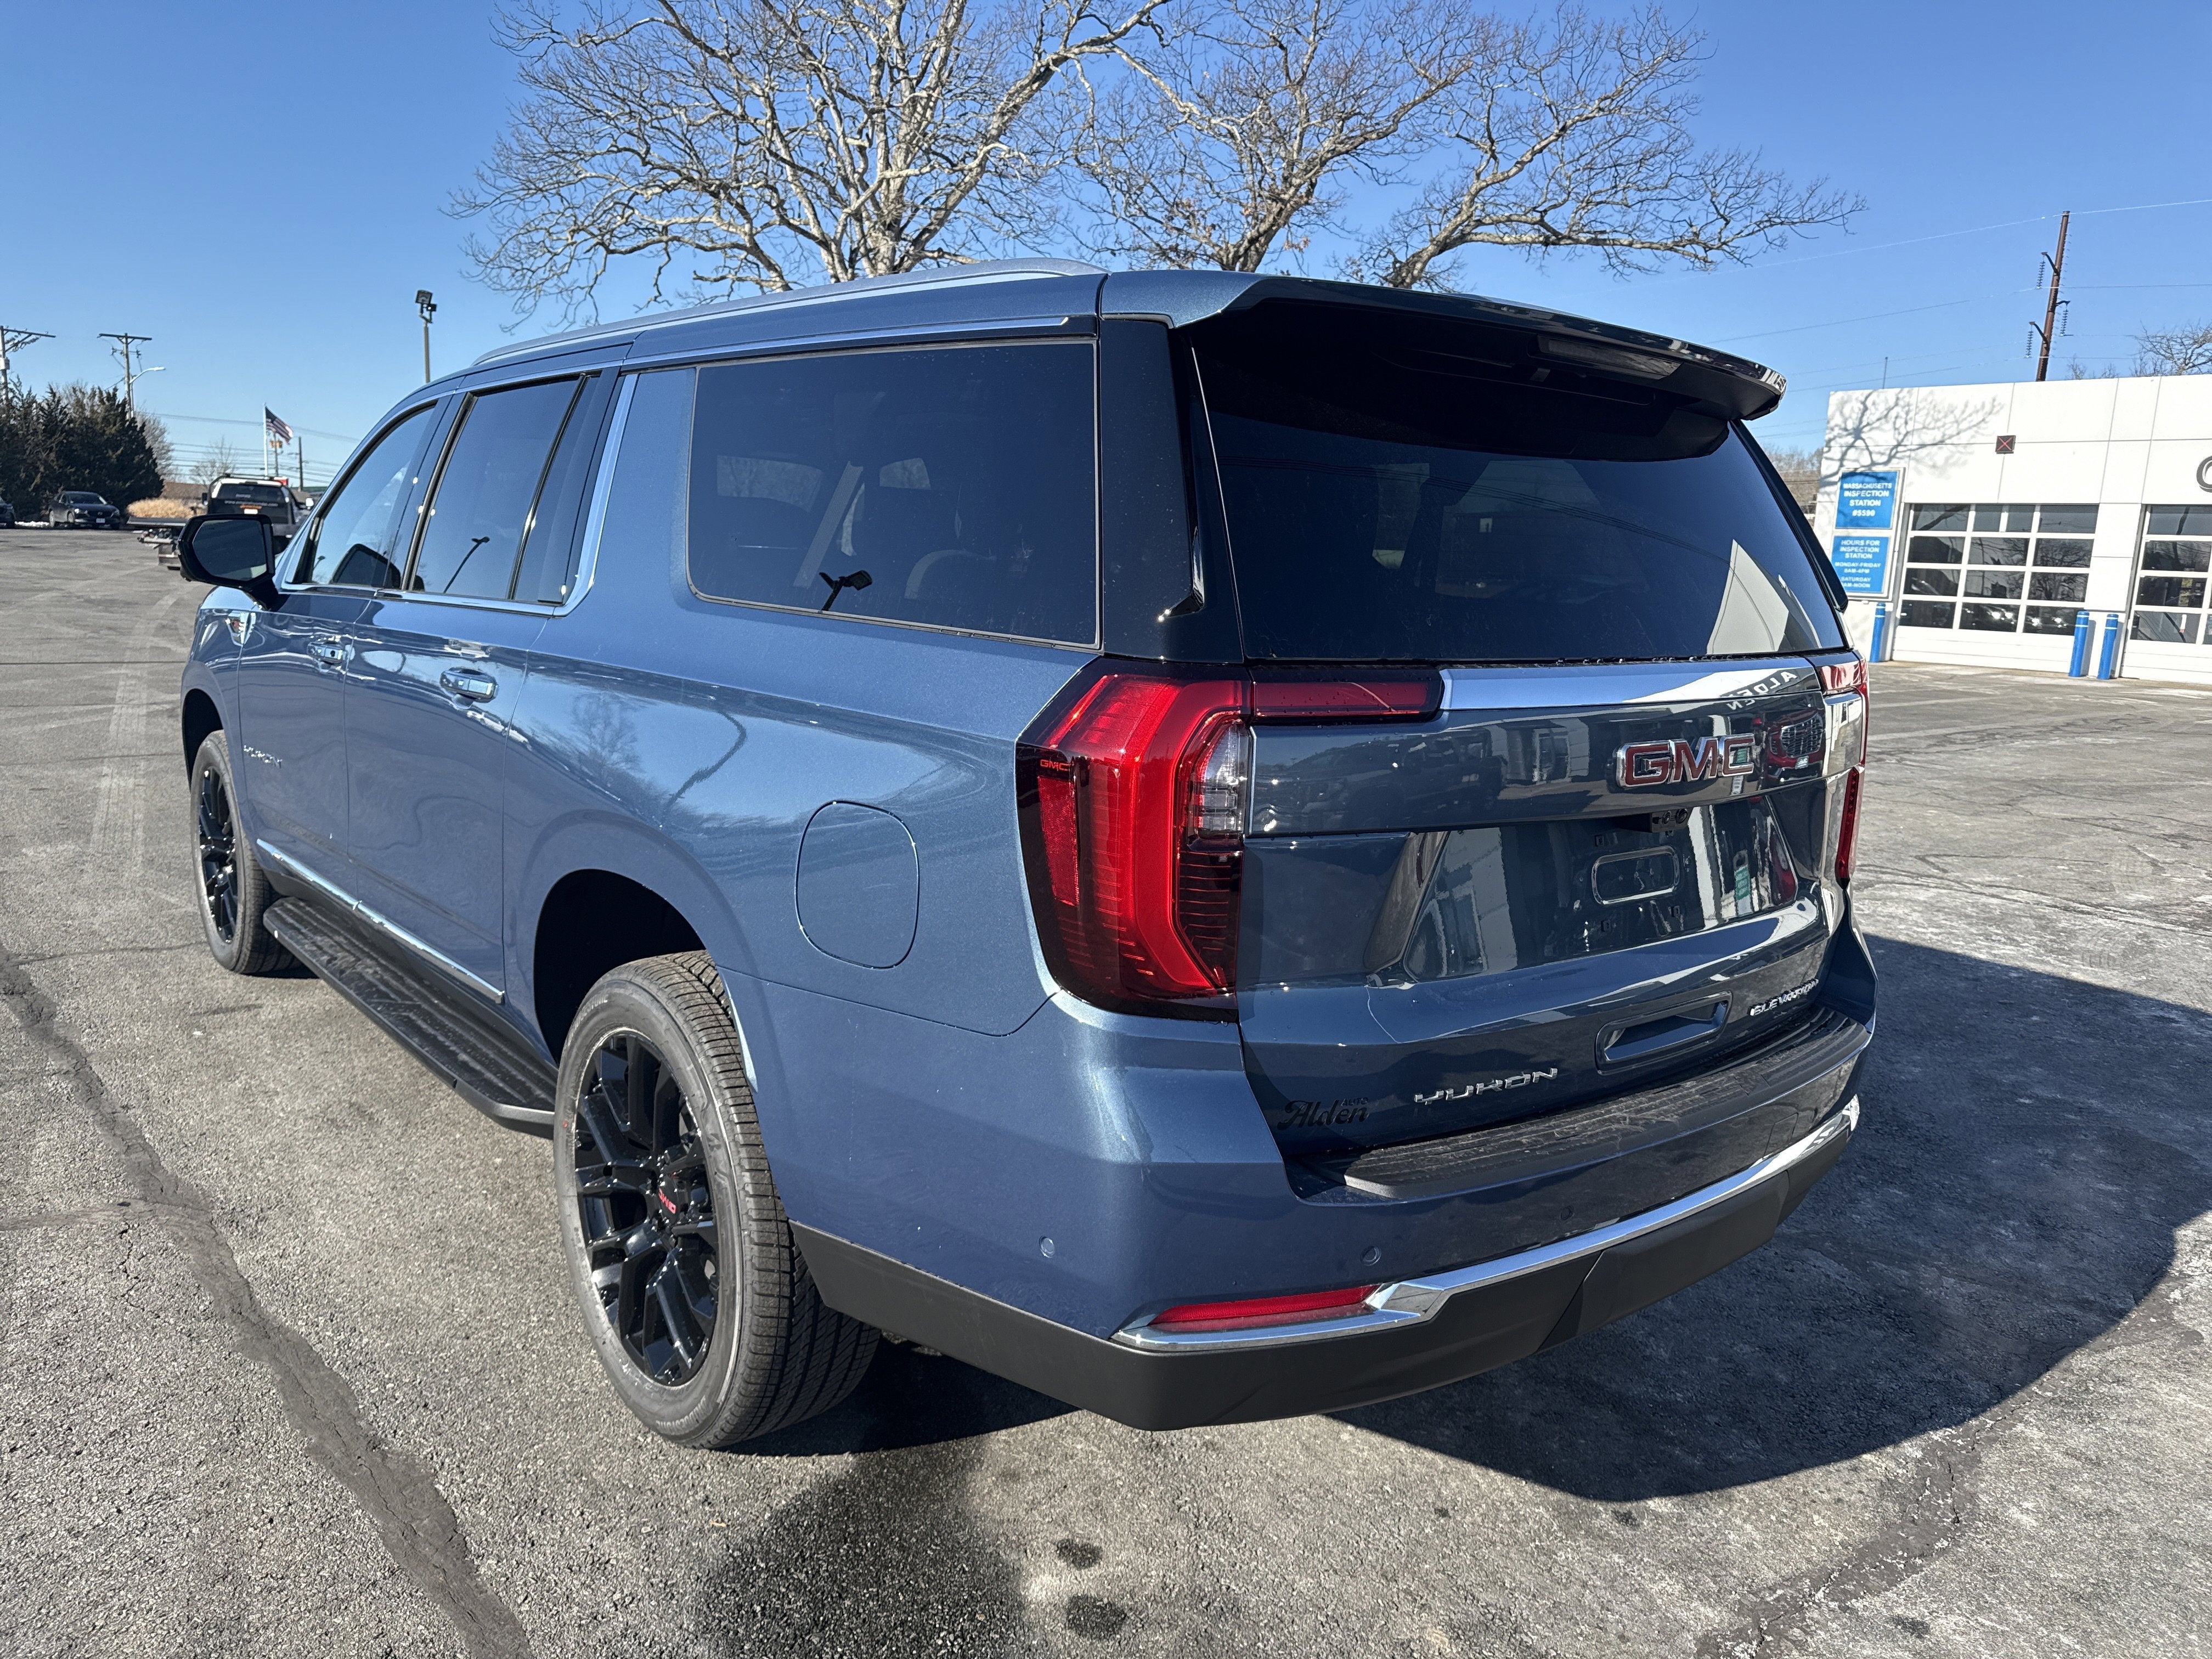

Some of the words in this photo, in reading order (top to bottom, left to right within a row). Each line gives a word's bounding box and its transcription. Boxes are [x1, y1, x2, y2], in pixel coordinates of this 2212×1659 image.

[1040, 759, 1070, 771] GMC
[1616, 733, 1756, 789] GMC
[1414, 1068, 1558, 1105] YUKON
[1277, 1099, 1370, 1131] Alden
[658, 1187, 676, 1215] GMC
